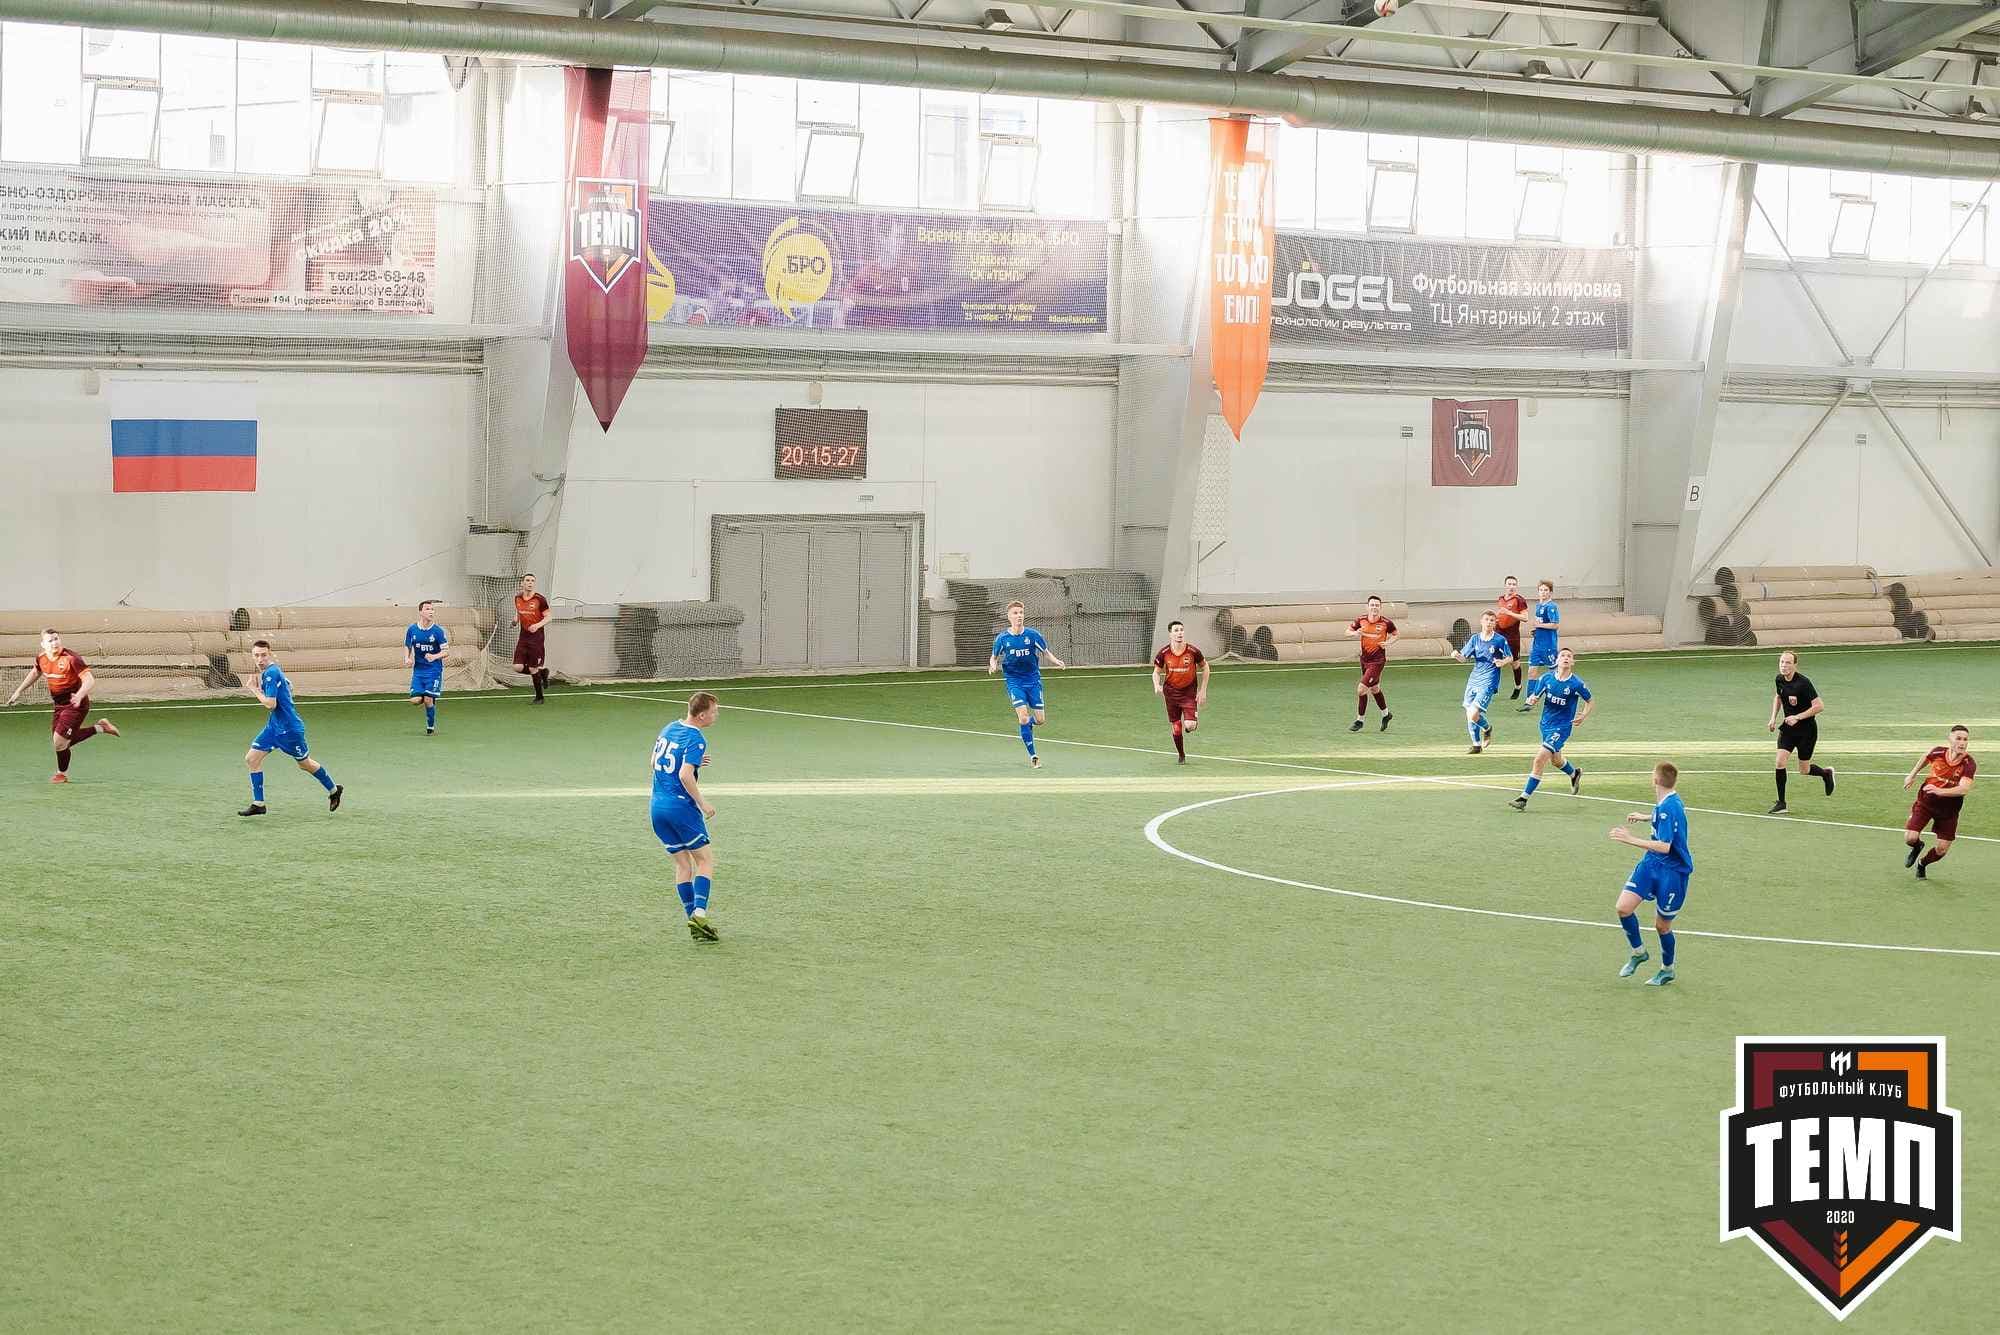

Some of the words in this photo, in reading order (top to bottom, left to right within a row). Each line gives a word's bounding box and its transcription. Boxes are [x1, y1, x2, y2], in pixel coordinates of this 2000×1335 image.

[578, 210, 636, 251] ТЕМП
[917, 226, 962, 245] Время
[1412, 272, 1518, 298] Футбольная
[1524, 279, 1622, 301] экипировка
[1342, 318, 1412, 332] результата
[1430, 302, 1453, 327] ТЦ
[1457, 304, 1546, 330] Янтарный,
[1551, 305, 1561, 326] 2
[1566, 309, 1605, 327] этаж
[1457, 427, 1488, 451] ТЕМП
[781, 445, 859, 466] 20:15:27
[653, 735, 680, 774] 25
[1668, 892, 1676, 905] 7
